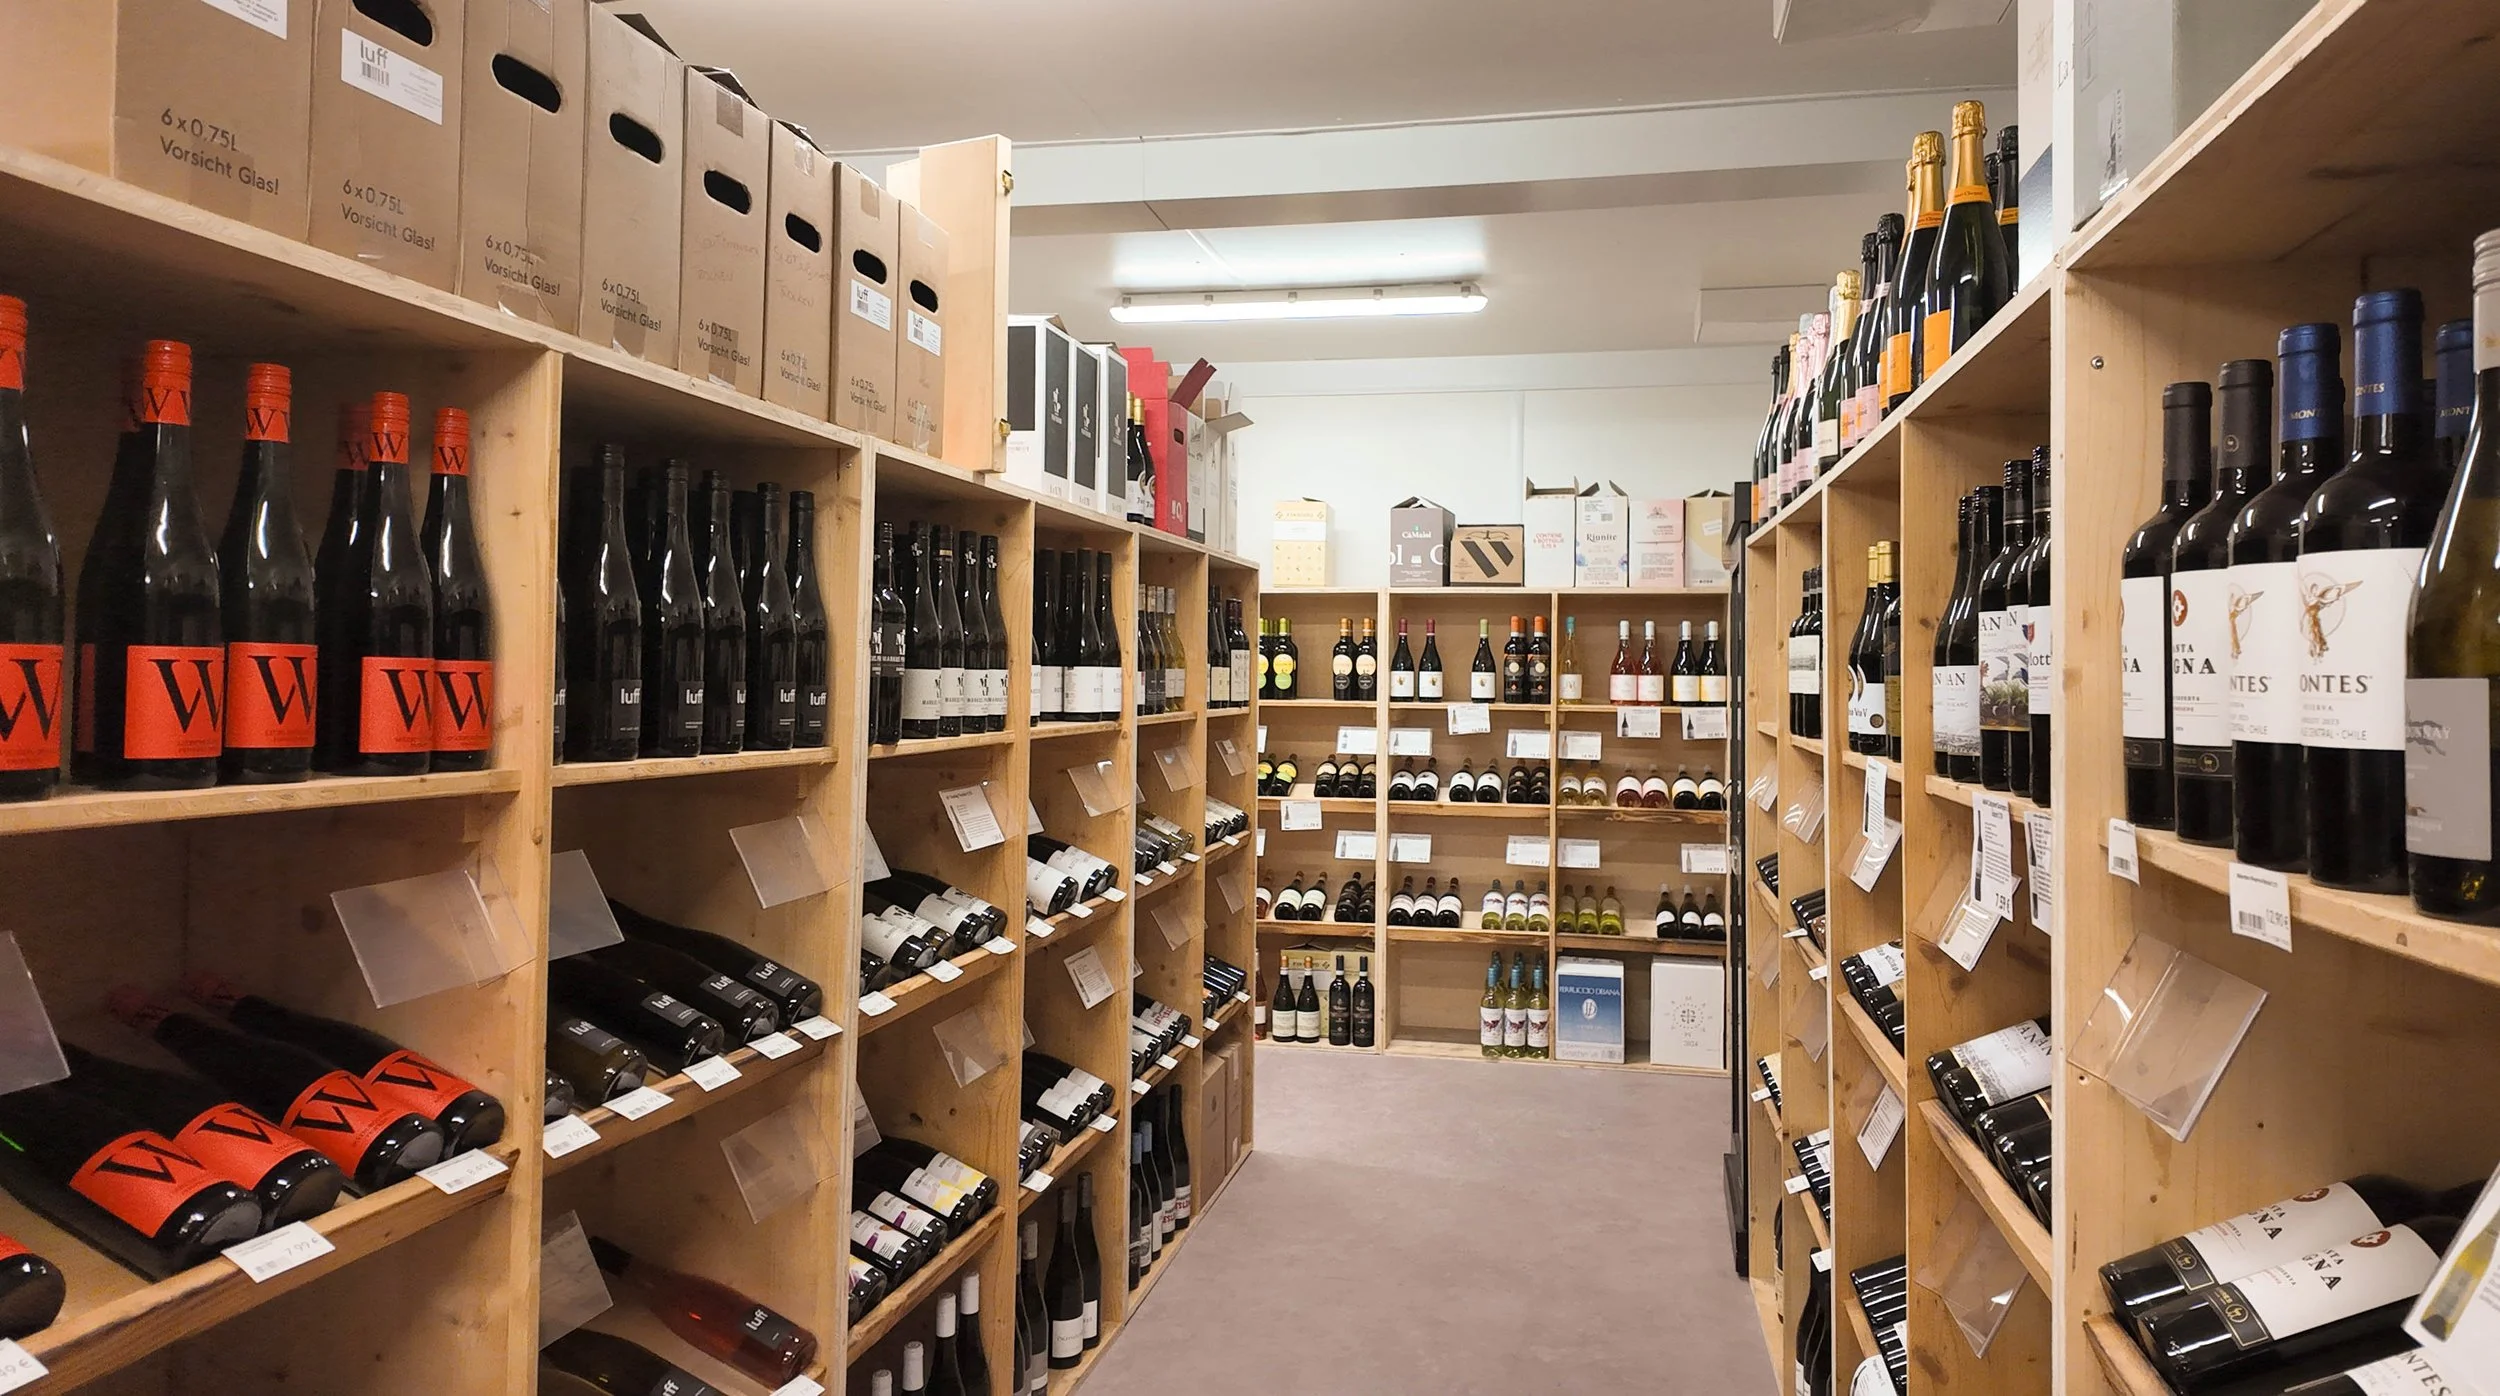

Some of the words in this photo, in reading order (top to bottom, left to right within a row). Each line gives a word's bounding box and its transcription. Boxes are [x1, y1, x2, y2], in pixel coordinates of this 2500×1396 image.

[360, 39, 389, 70] luff
[160, 135, 232, 179] Vorsicht
[238, 166, 279, 196] Glas!
[341, 203, 398, 238] Vorsicht
[402, 226, 436, 252] Glas!
[485, 256, 528, 285] Vorsicht
[531, 275, 561, 297] Glas!
[600, 298, 637, 324] Vorsicht
[639, 313, 661, 333] Glas!
[698, 337, 730, 361] Vorsicht
[731, 350, 750, 367] Glas!
[371, 431, 404, 459] W
[437, 445, 467, 471] W
[2173, 657, 2217, 675] GNA
[148, 658, 224, 734] W
[247, 655, 318, 726] W
[553, 688, 566, 706] uff
[620, 688, 641, 705] luff
[685, 689, 703, 705] luff
[780, 689, 796, 703] luff
[2229, 675, 2269, 693] NTES
[2299, 673, 2369, 694] ONTES
[380, 668, 434, 733] W
[435, 671, 493, 732] W
[809, 692, 827, 707] luff
[2340, 730, 2367, 741] CHILE
[710, 974, 736, 991] luff
[755, 961, 780, 980] luff
[651, 994, 678, 1009] luff
[569, 1021, 598, 1036] luff
[372, 1054, 462, 1092] W
[293, 1073, 380, 1135] W
[194, 1107, 283, 1146] W
[94, 1139, 205, 1185] W
[745, 1308, 769, 1331] luff
[2398, 1350, 2452, 1396] NTES
